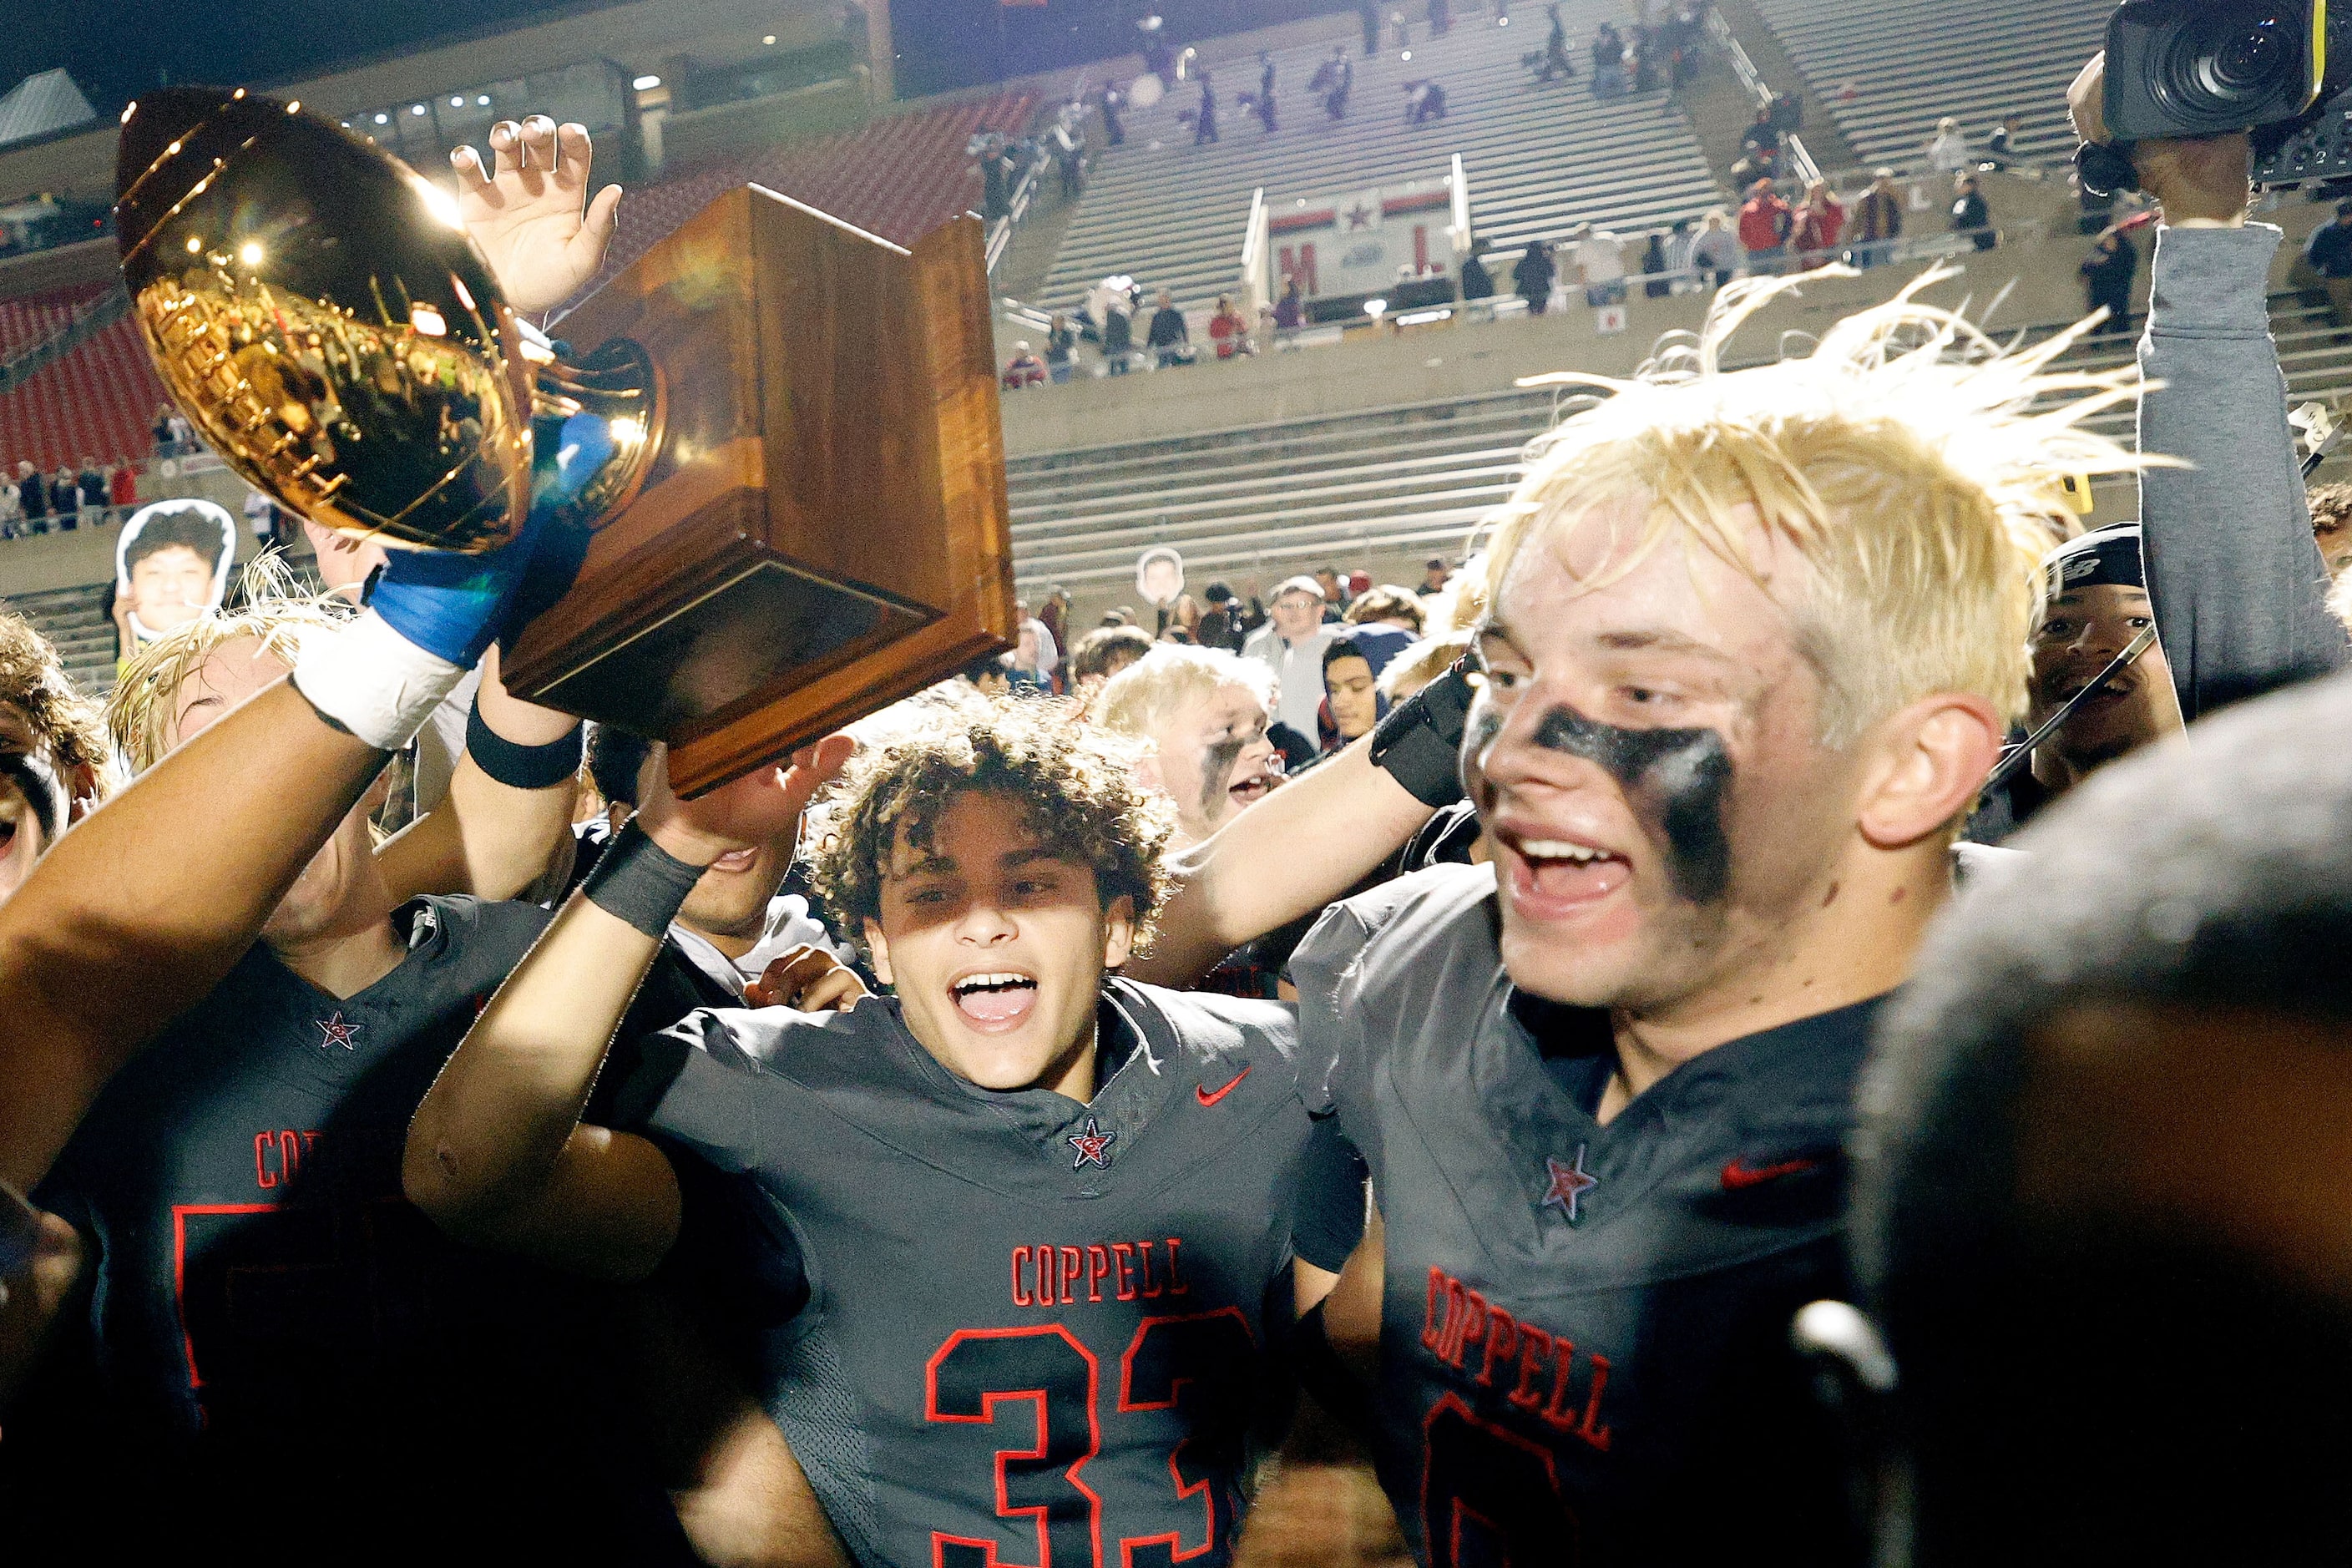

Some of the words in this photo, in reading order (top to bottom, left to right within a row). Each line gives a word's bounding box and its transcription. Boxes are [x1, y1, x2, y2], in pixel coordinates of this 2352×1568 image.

[254, 1129, 324, 1189] CO
[1011, 1238, 1191, 1307] COPPELL
[1421, 1264, 1612, 1452] COPPELL
[925, 1306, 1257, 1568] 33
